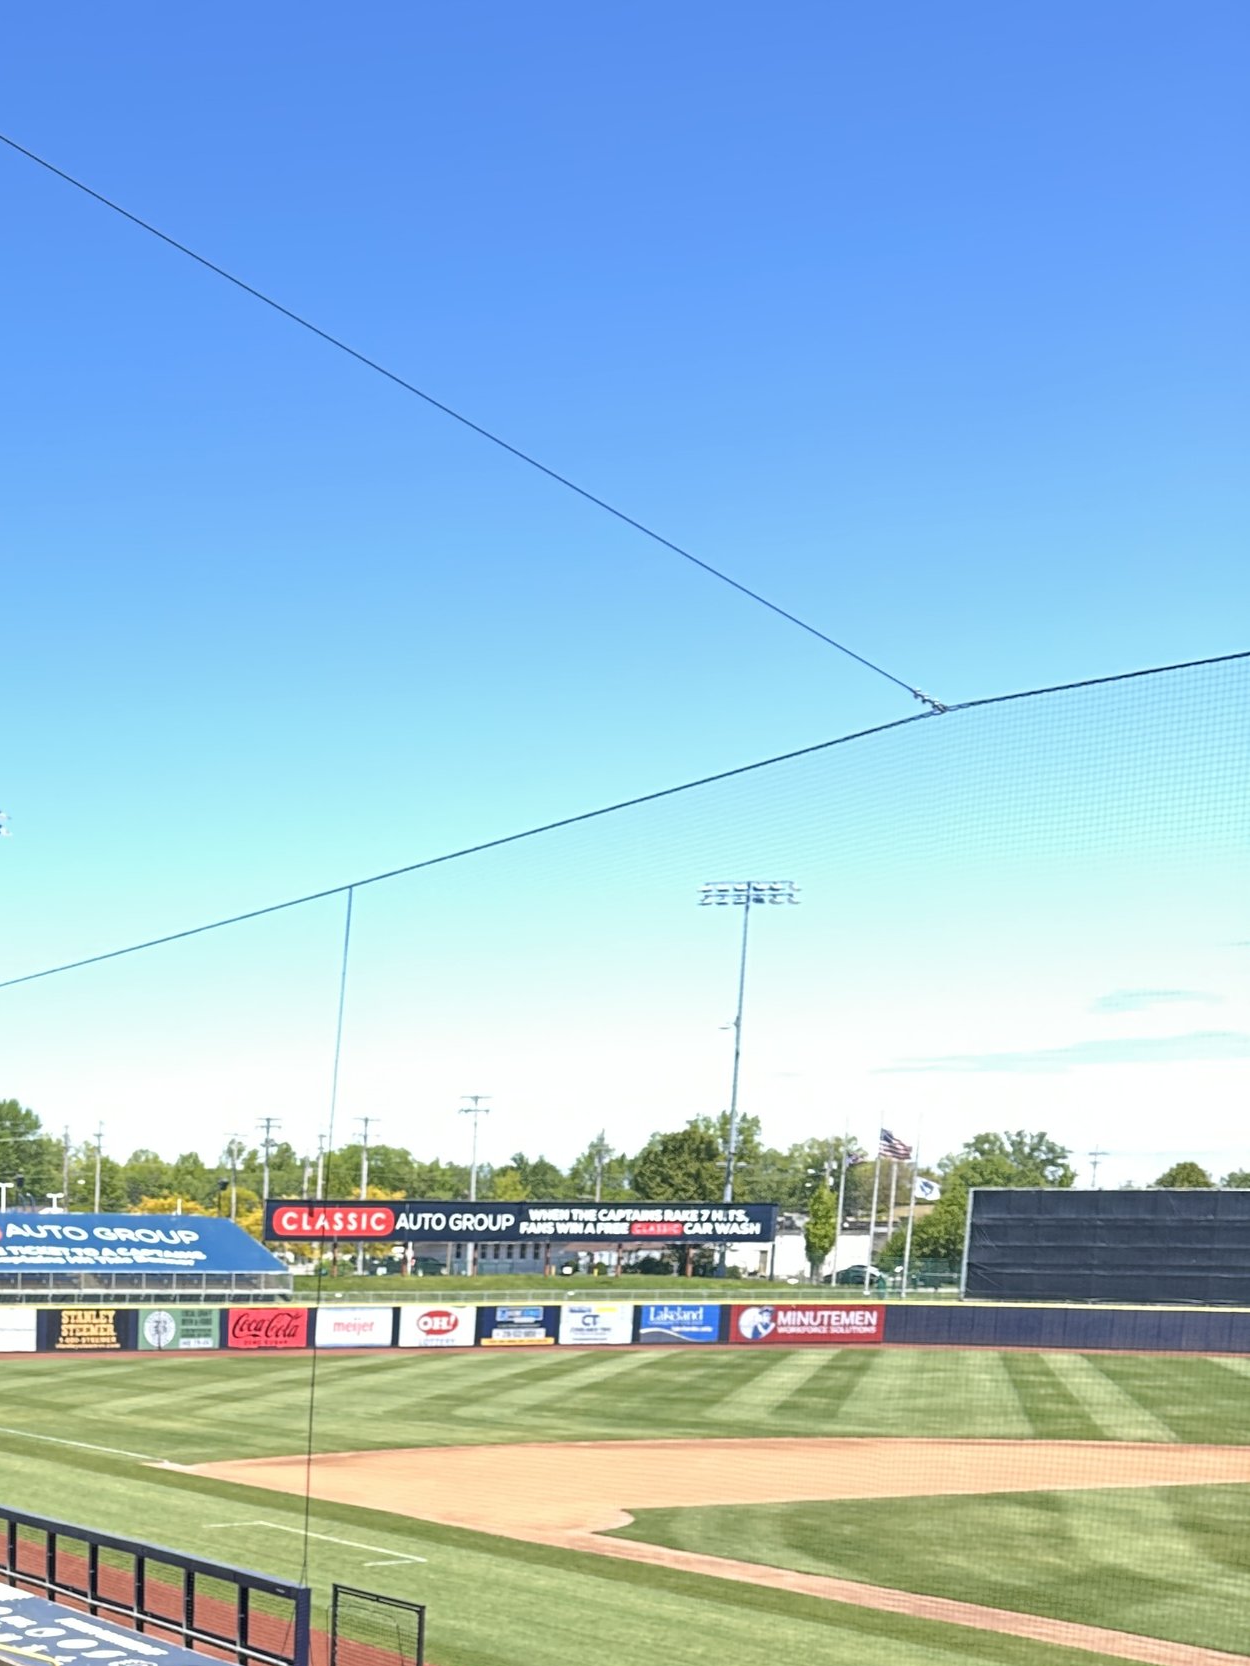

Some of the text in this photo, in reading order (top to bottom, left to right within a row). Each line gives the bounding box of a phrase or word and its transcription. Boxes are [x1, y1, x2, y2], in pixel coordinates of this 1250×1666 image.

[281, 1211, 515, 1232] CLASSIC AUTO GROUP
[528, 1208, 570, 1222] WHEN
[572, 1209, 597, 1221] THE
[599, 1209, 662, 1222] CAPTAINS
[664, 1209, 699, 1222] RAKE
[700, 1209, 709, 1222] 7
[6, 1222, 89, 1241] AUTO
[93, 1226, 200, 1245] GROUP
[519, 1222, 556, 1235] FANS
[557, 1222, 583, 1235] WIN
[584, 1222, 596, 1235] A
[597, 1222, 629, 1235] FREE
[683, 1222, 713, 1235] CAR
[715, 1222, 762, 1235] WASH
[61, 1309, 116, 1324] STANLEY
[582, 1314, 601, 1327] CT
[649, 1305, 704, 1323] Lakeland
[777, 1310, 878, 1326] MINUTEMEN
[61, 1324, 116, 1337] STEEMER
[332, 1317, 374, 1336] meijer
[418, 1316, 456, 1332] OH!
[777, 1326, 877, 1334] WORKFORCE SOLUTIONS
